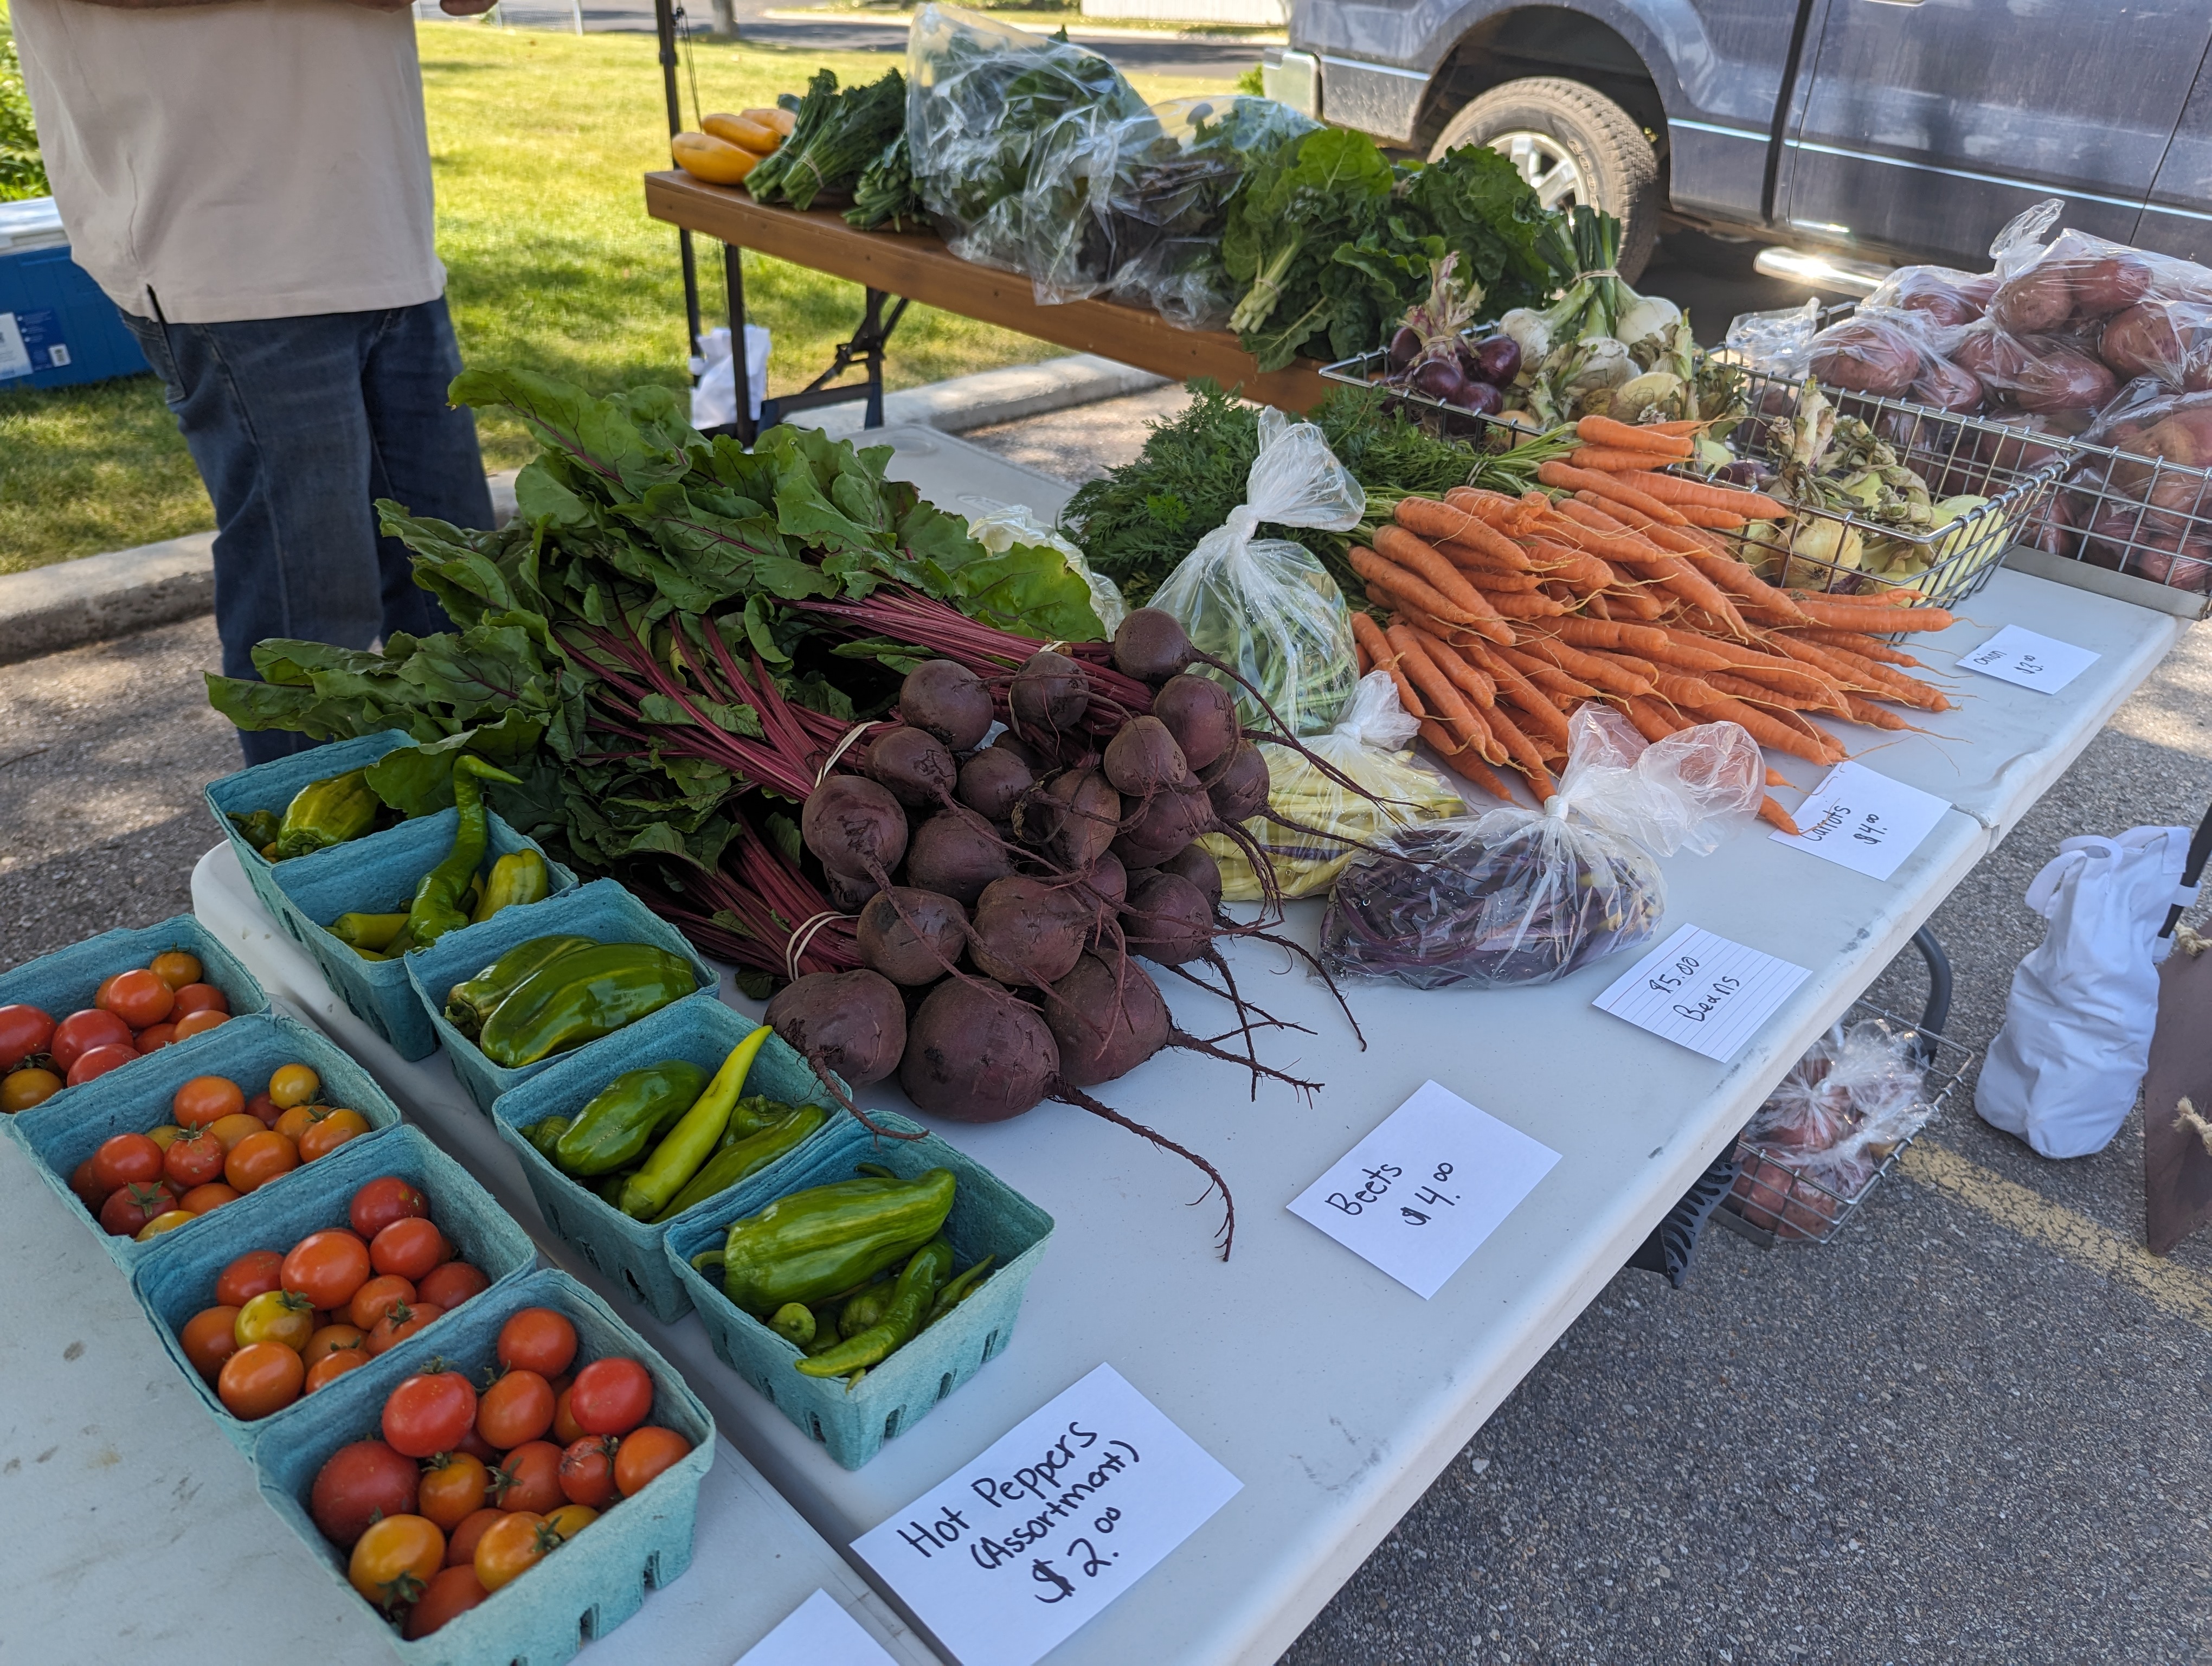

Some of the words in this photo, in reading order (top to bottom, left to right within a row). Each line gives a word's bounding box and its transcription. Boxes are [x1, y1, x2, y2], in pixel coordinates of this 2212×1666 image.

[1649, 956, 1700, 994] $5.00
[1324, 1164, 1403, 1216] Beets
[896, 1505, 971, 1558] Hot
[970, 1421, 1097, 1509] Peppers
